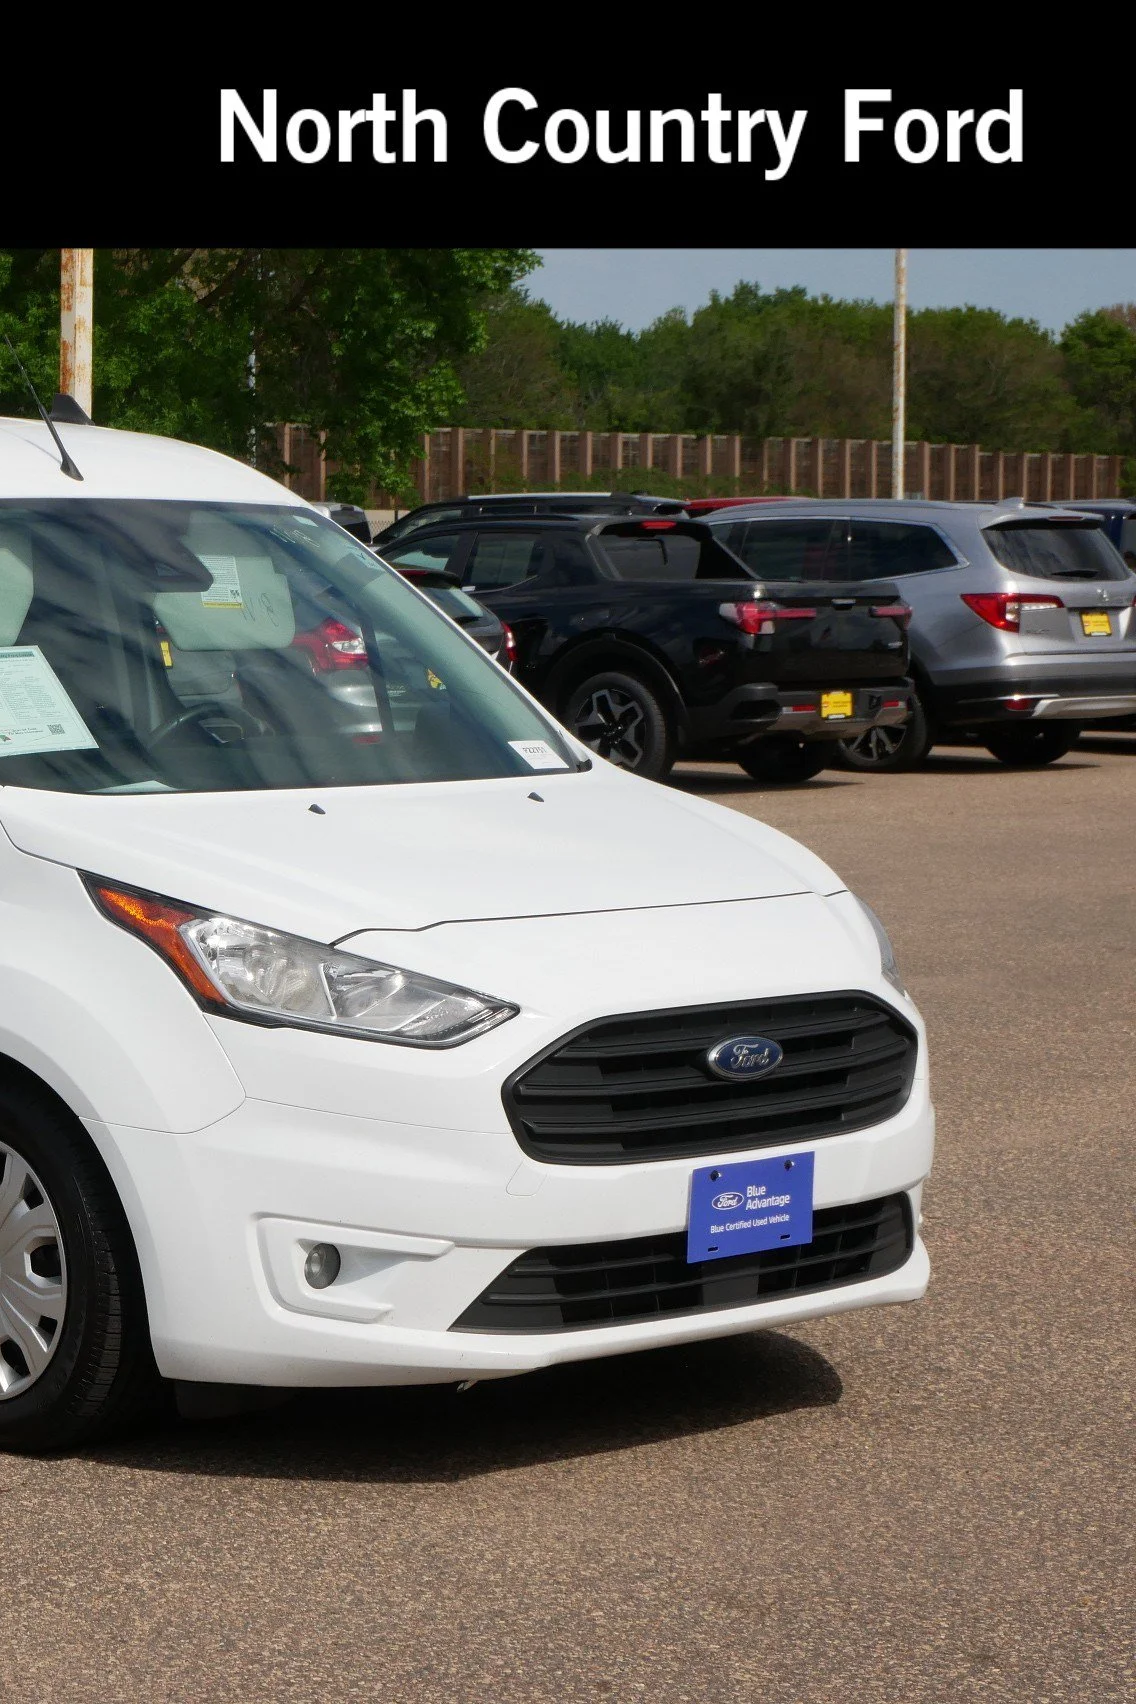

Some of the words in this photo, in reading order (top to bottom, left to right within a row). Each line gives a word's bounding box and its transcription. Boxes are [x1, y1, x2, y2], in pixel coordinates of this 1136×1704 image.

[731, 1043, 770, 1070] Ford
[746, 1185, 767, 1198] Blue
[717, 1194, 738, 1208] Ford
[745, 1194, 791, 1211] Advantage
[710, 1225, 725, 1234] Blue
[725, 1220, 752, 1231] Certified
[752, 1217, 768, 1228] Used
[768, 1213, 790, 1224] Vehicle
